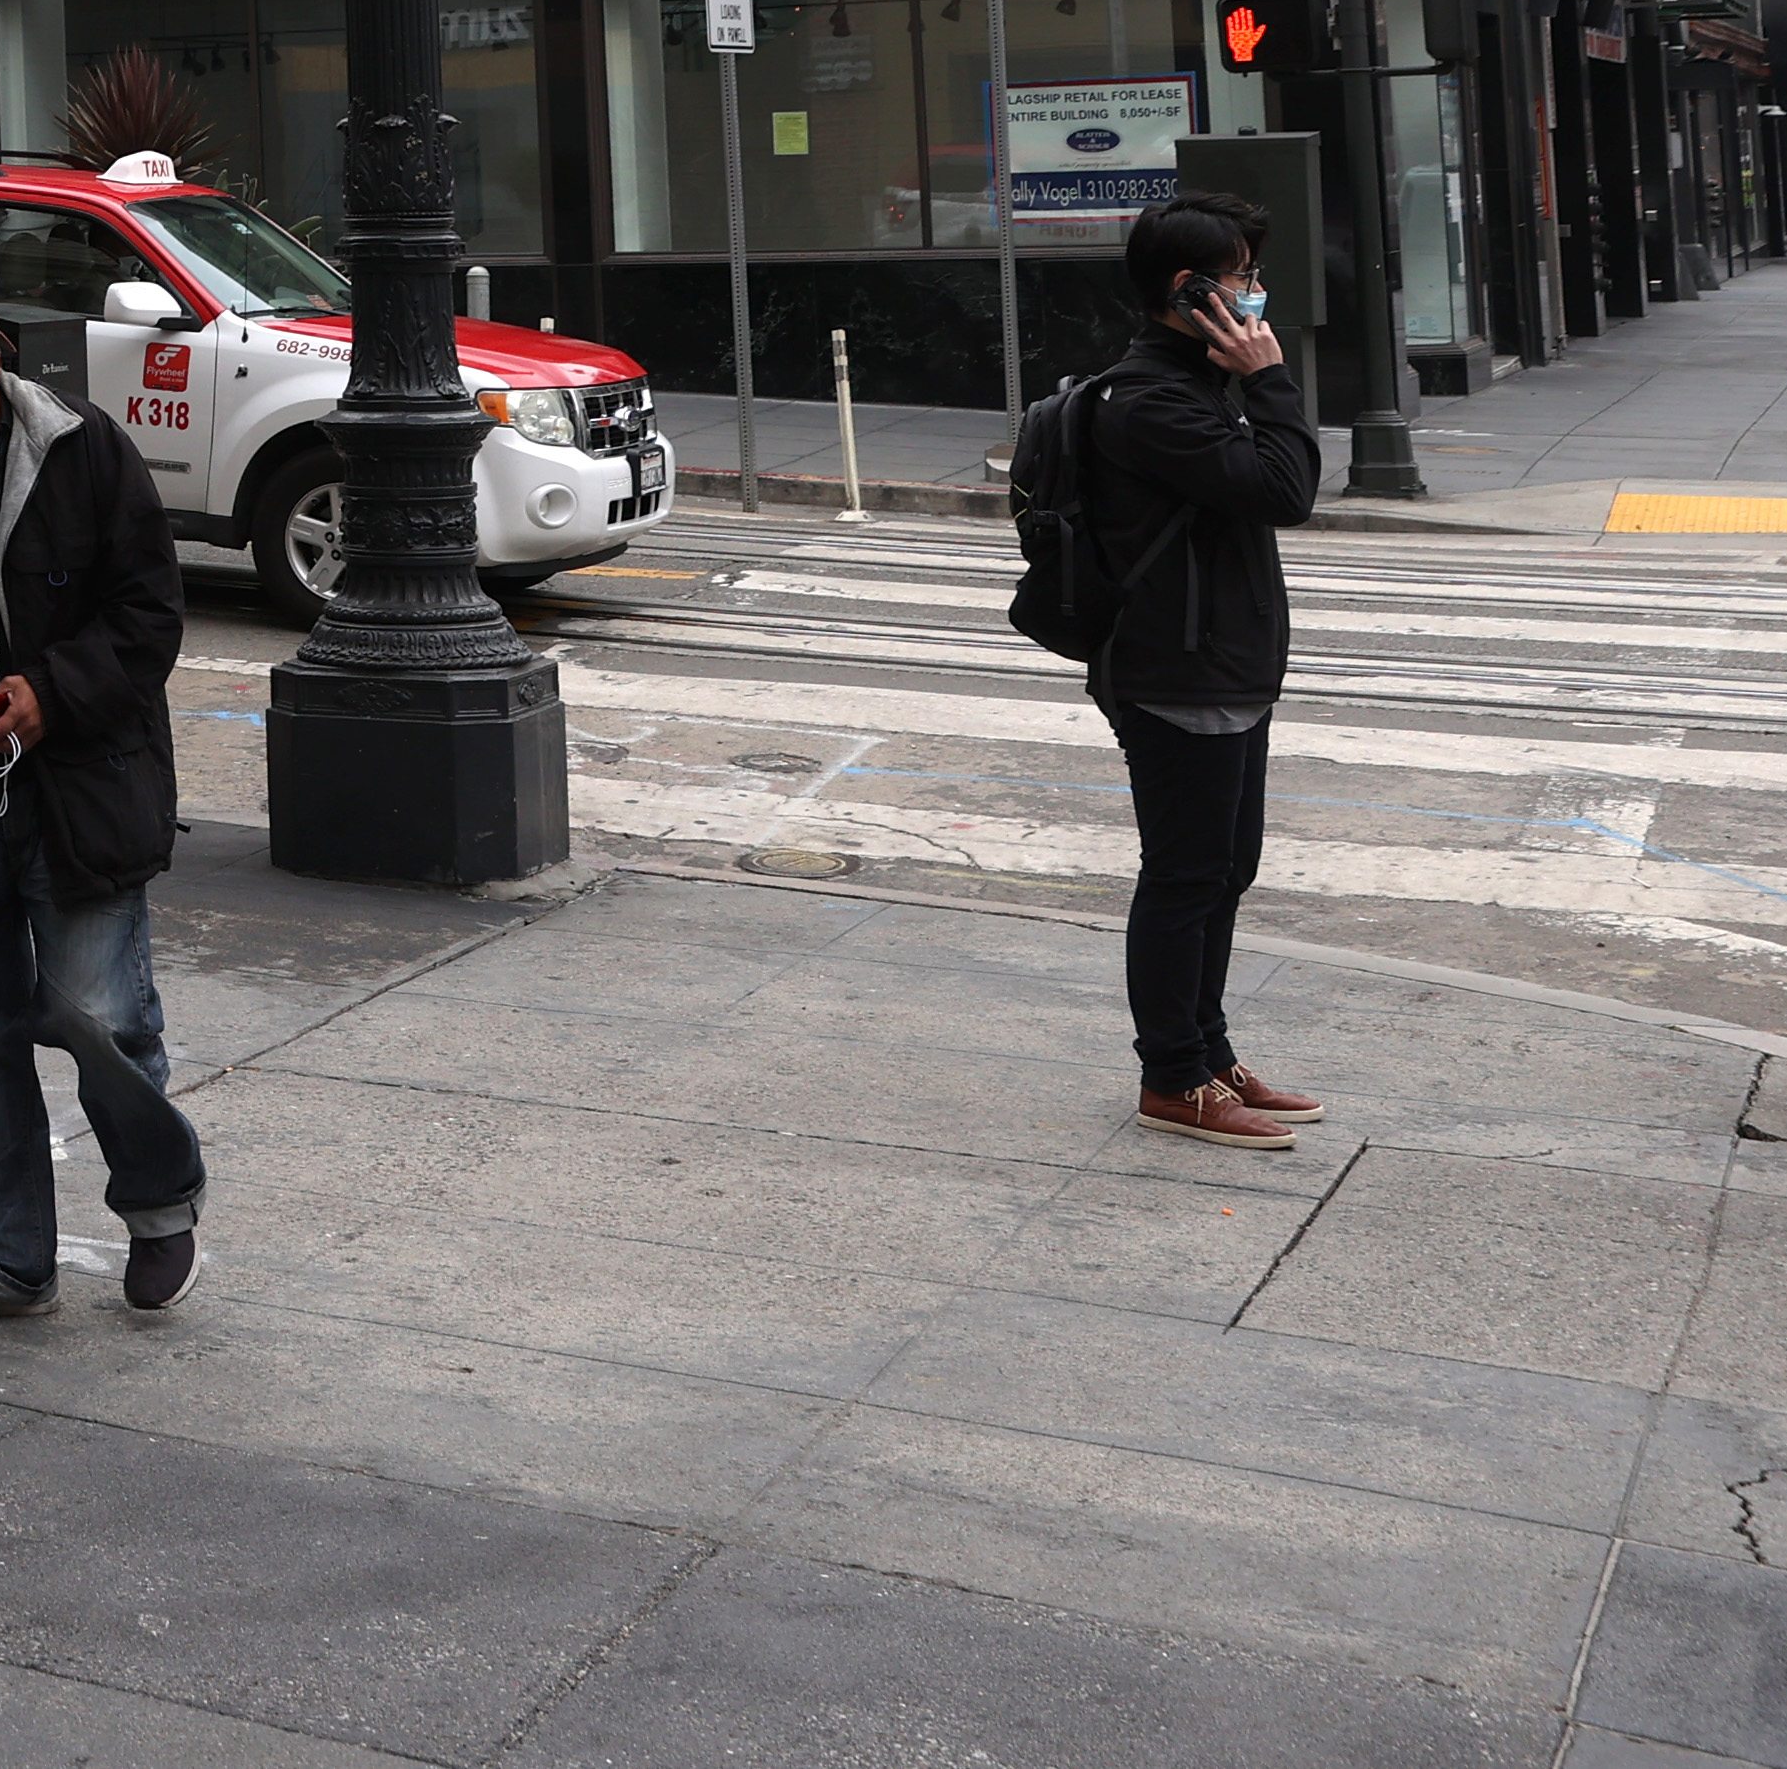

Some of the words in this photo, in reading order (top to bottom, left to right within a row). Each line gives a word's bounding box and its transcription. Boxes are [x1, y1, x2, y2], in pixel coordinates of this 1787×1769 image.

[1064, 90, 1108, 103] RETAIL
[1112, 90, 1137, 101] FOR
[1141, 88, 1182, 100] LEASE
[1050, 109, 1109, 120] BUILDING
[143, 160, 170, 178] TAXI
[1039, 179, 1081, 206] Vogel
[146, 365, 187, 380] Flywheel
[126, 396, 144, 425] K
[148, 398, 190, 430] 318
